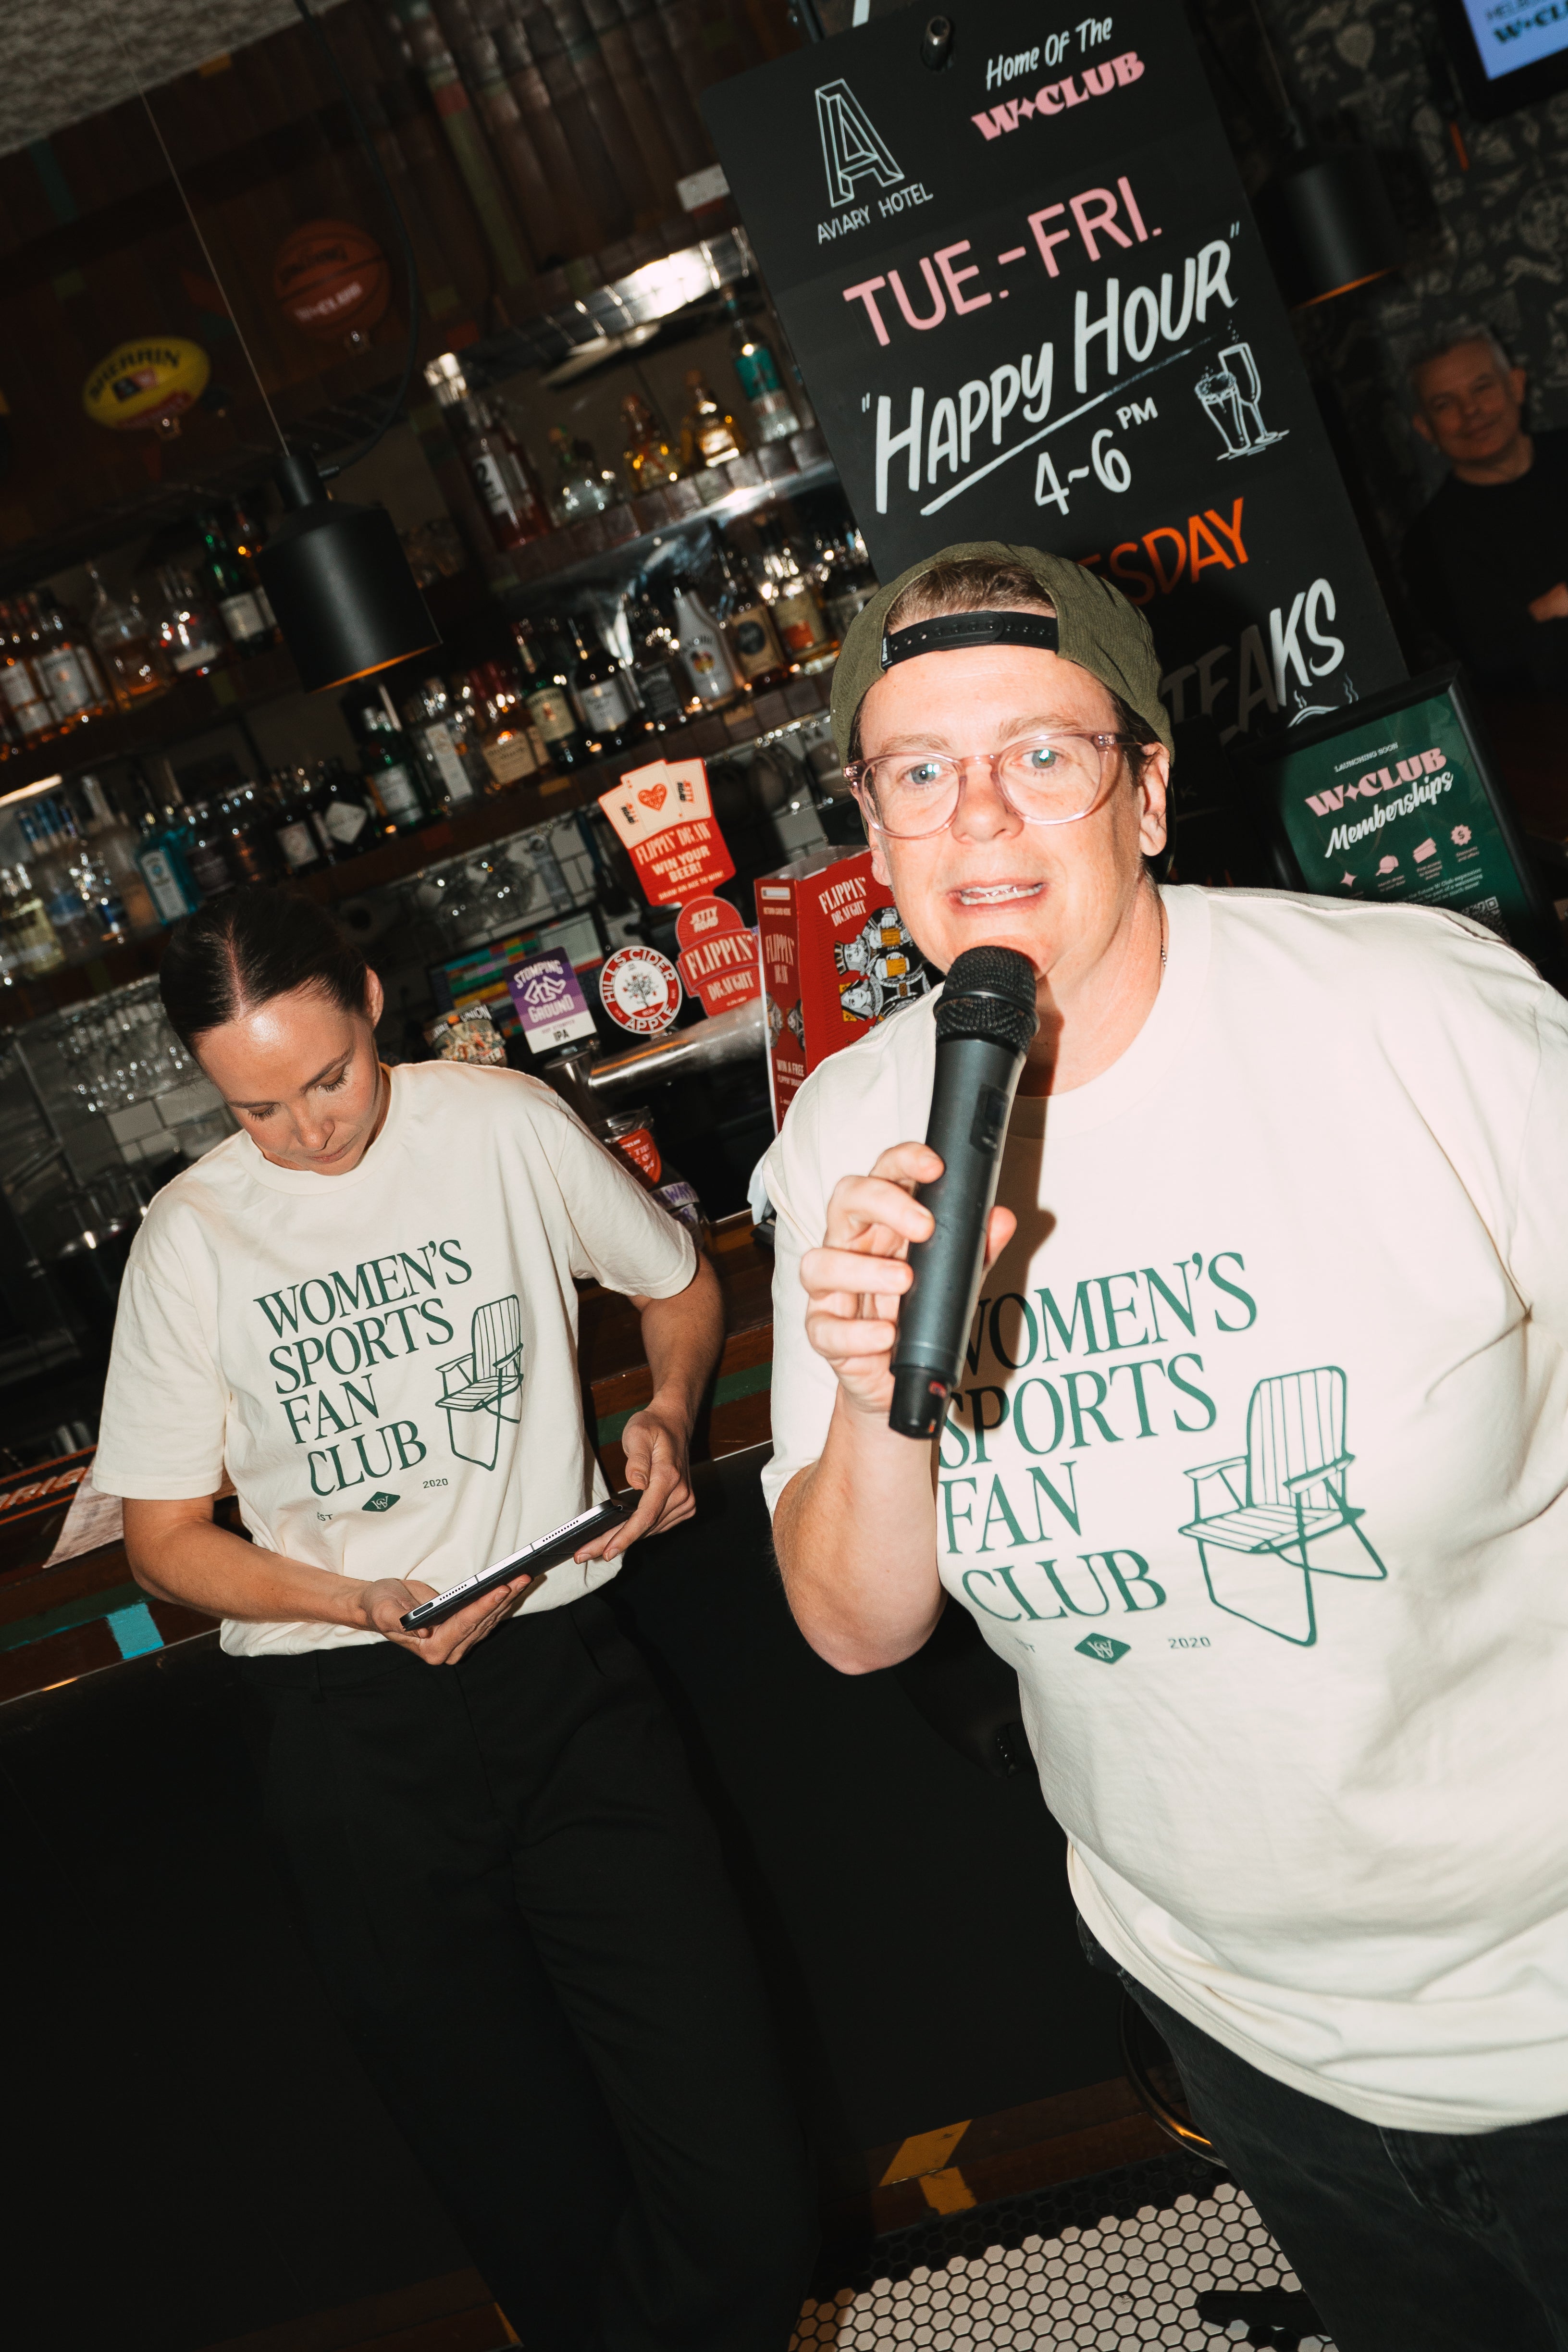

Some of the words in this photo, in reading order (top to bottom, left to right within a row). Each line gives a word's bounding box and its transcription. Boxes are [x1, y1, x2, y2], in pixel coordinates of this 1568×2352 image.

[985, 46, 1039, 91] Home
[1045, 30, 1071, 69] Of
[1075, 16, 1112, 62] The
[817, 206, 872, 244] AVIARY
[877, 183, 934, 221] HOTEL
[1115, 397, 1158, 431] PM
[1077, 496, 1248, 606] SDAY
[1334, 751, 1377, 773] LAUNCHING
[1378, 742, 1398, 756] SOON
[1324, 771, 1454, 858] Memberships
[652, 858, 679, 876] WIN
[678, 845, 711, 866] YOUR
[668, 863, 703, 883] BEER!
[818, 877, 867, 915] FLIPPIN'
[831, 899, 866, 927] DRAUGHT
[513, 959, 564, 990] STOMPING
[603, 953, 627, 1004] HILLS
[629, 948, 676, 981] CIDER
[684, 933, 753, 980] FLIPPIN'
[707, 970, 754, 1002] DRAUGHT
[527, 993, 575, 1023] GROUND
[624, 1003, 676, 1031] APPLE
[253, 1239, 472, 1339] WOMEN'S
[269, 1298, 454, 1395] SPORTS
[280, 1373, 380, 1444] FAN
[307, 1420, 427, 1497] CLUB
[423, 1478, 448, 1489] 2020
[938, 1460, 1083, 1556] FAN
[961, 1548, 1166, 1623] CLUB
[1168, 1637, 1211, 1649] 2020
